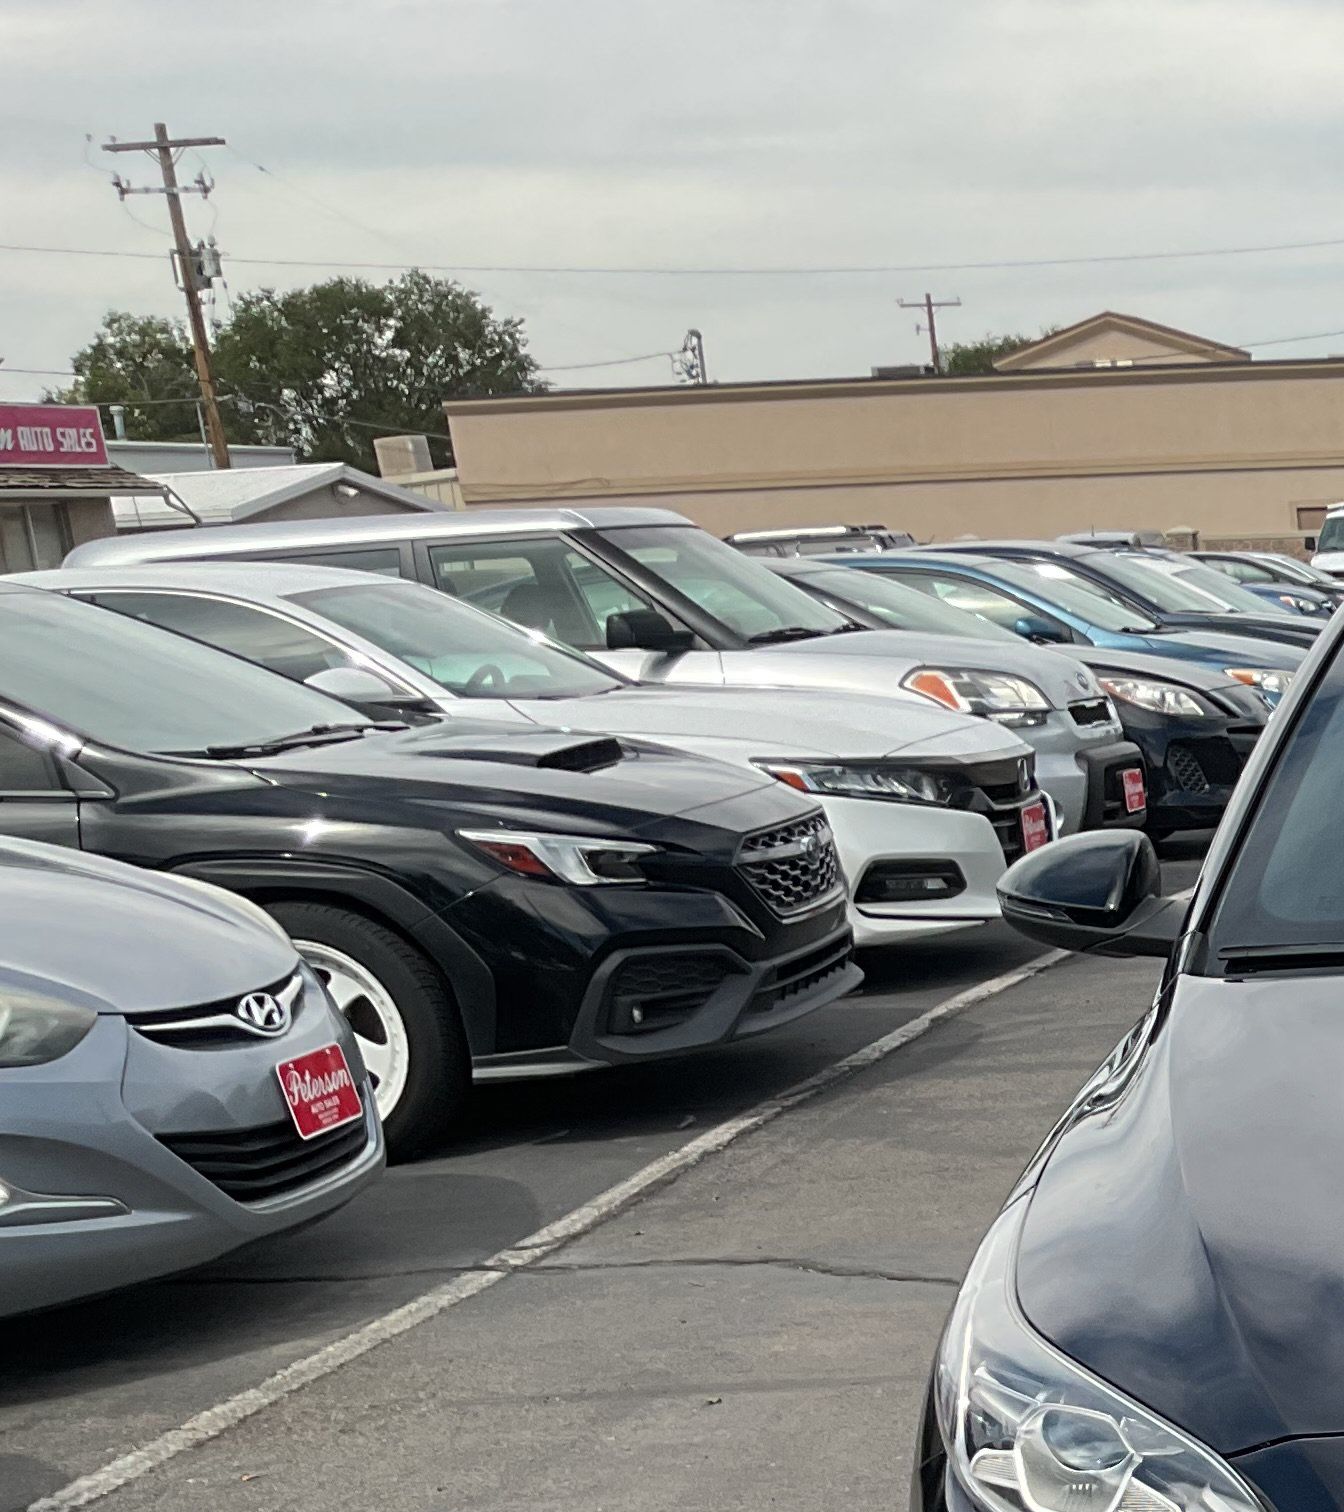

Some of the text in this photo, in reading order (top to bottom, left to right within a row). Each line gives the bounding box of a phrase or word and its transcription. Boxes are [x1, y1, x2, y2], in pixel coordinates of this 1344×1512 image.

[17, 426, 54, 452] AUTO
[56, 427, 97, 453] SALES
[285, 1069, 350, 1106] Peterson
